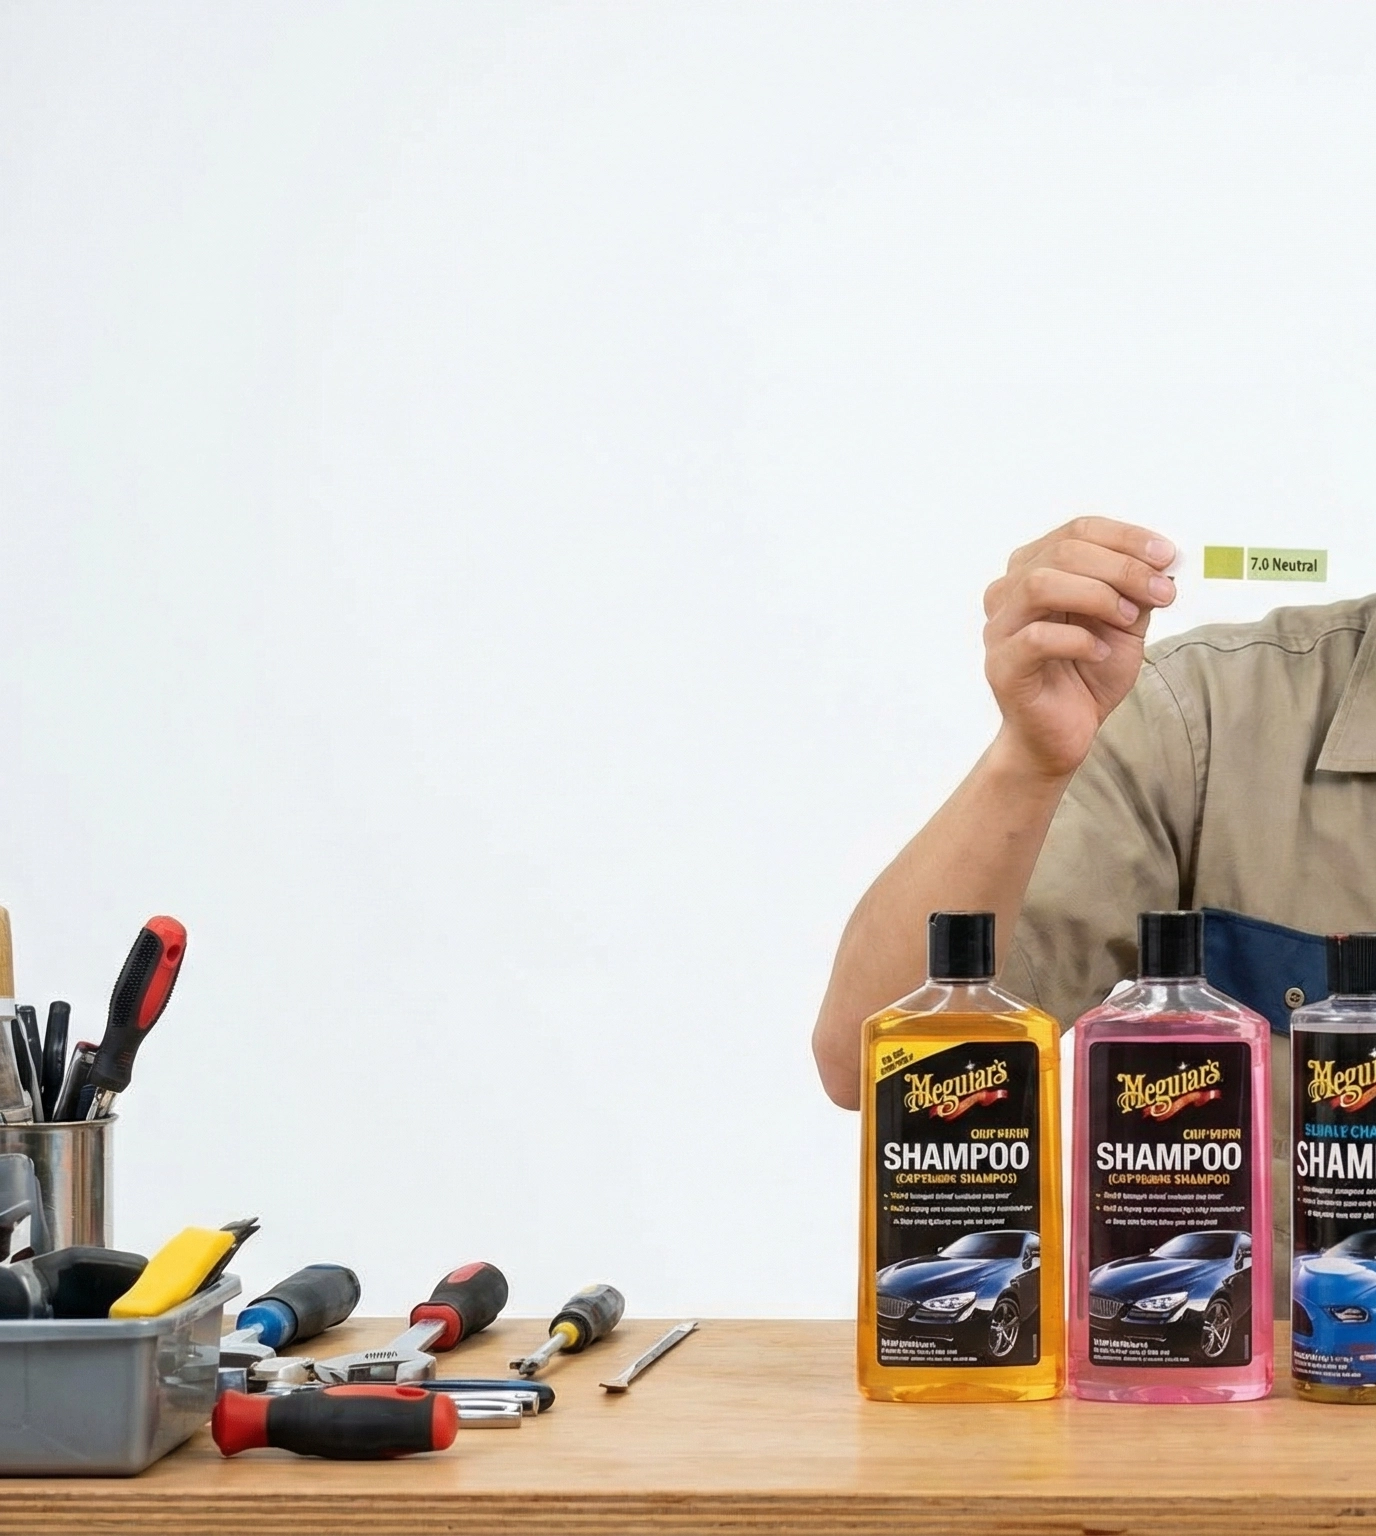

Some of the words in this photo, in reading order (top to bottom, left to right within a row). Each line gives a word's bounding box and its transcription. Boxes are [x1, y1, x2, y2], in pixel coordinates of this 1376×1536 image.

[1250, 557, 1270, 571] 7.0
[1272, 557, 1318, 572] Neutral
[904, 1058, 1009, 1118] Meguiar's
[1116, 1058, 1221, 1118] Meguiar's
[883, 1141, 1030, 1171] SHAMPOO
[1096, 1141, 1242, 1171] SHAMPOO
